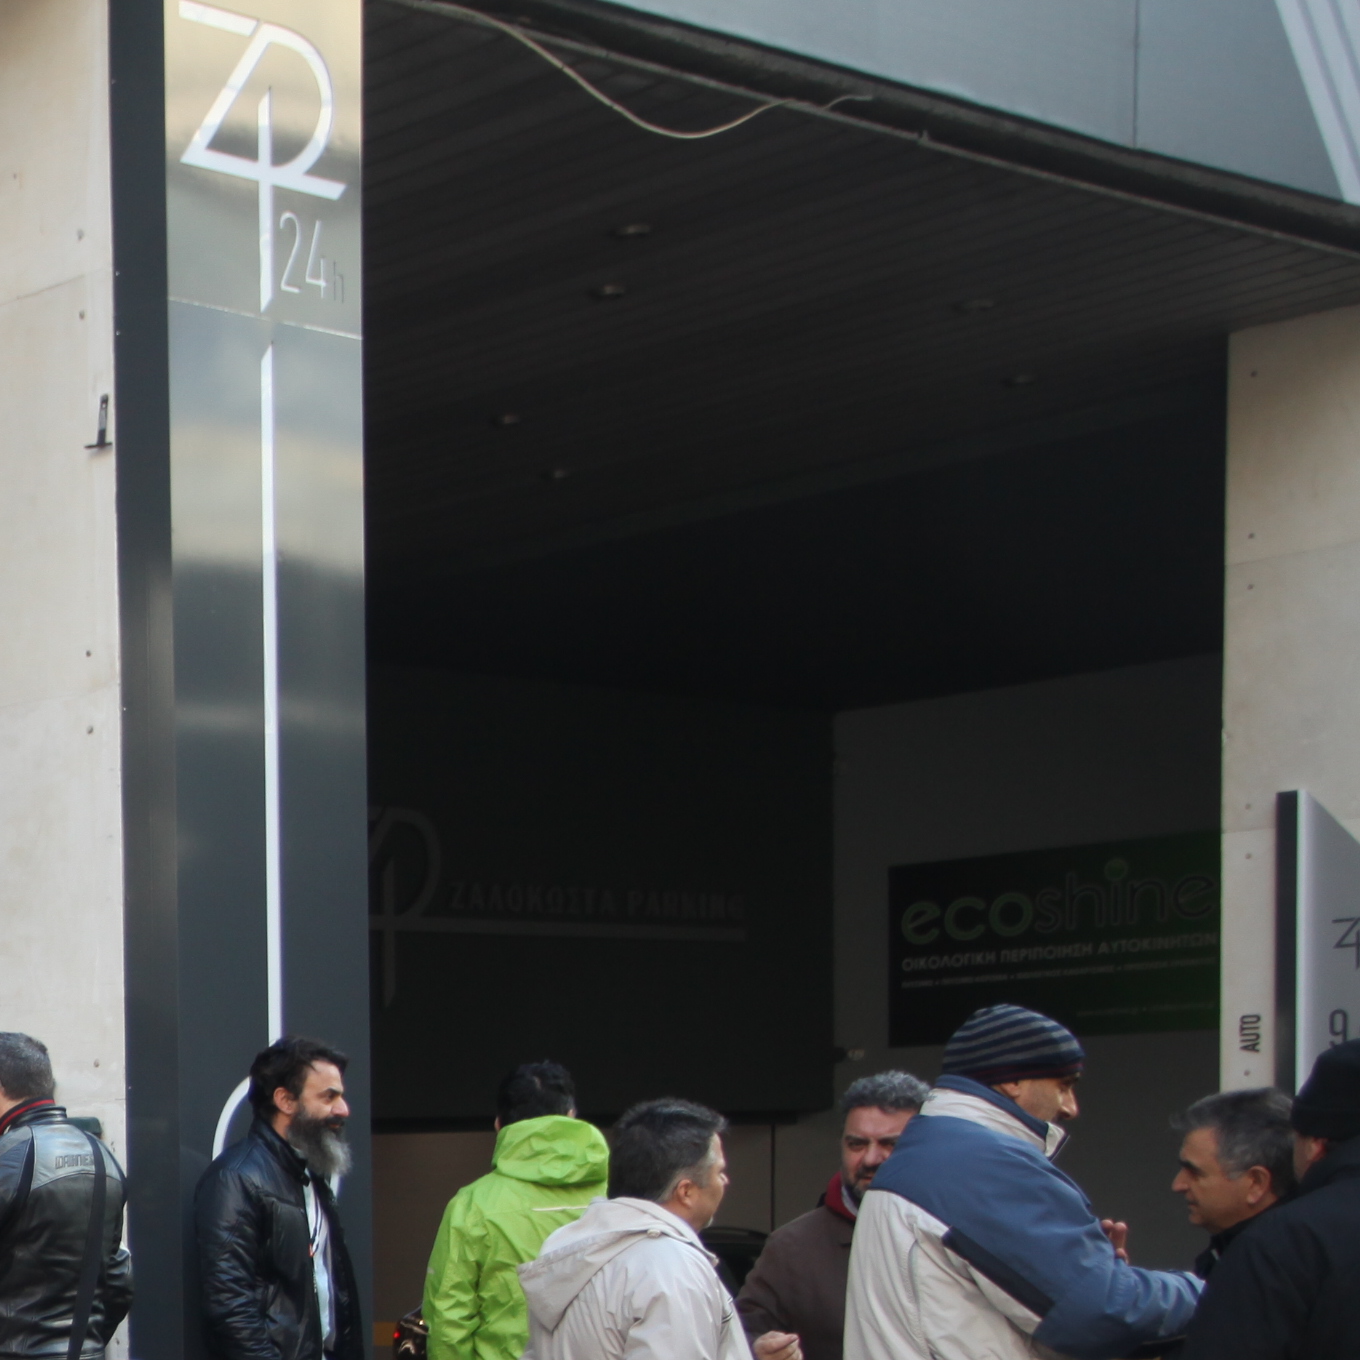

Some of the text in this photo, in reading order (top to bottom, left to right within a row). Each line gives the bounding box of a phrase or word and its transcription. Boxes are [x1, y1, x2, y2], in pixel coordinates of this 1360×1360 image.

[447, 880, 747, 921] ΖΑΛΟΚΩΣΤΑ PARKING
[900, 856, 1216, 946] ecoshine
[901, 951, 997, 972] ΟΙΚΟΛΟΓΙΚΗ
[1000, 942, 1094, 964] ΠΕΡΙΠΟΙΗΣΗ
[1097, 931, 1218, 957] ΑΥΤΟΚΙΝΗΤΩΝ
[1239, 1013, 1262, 1054] AUTO
